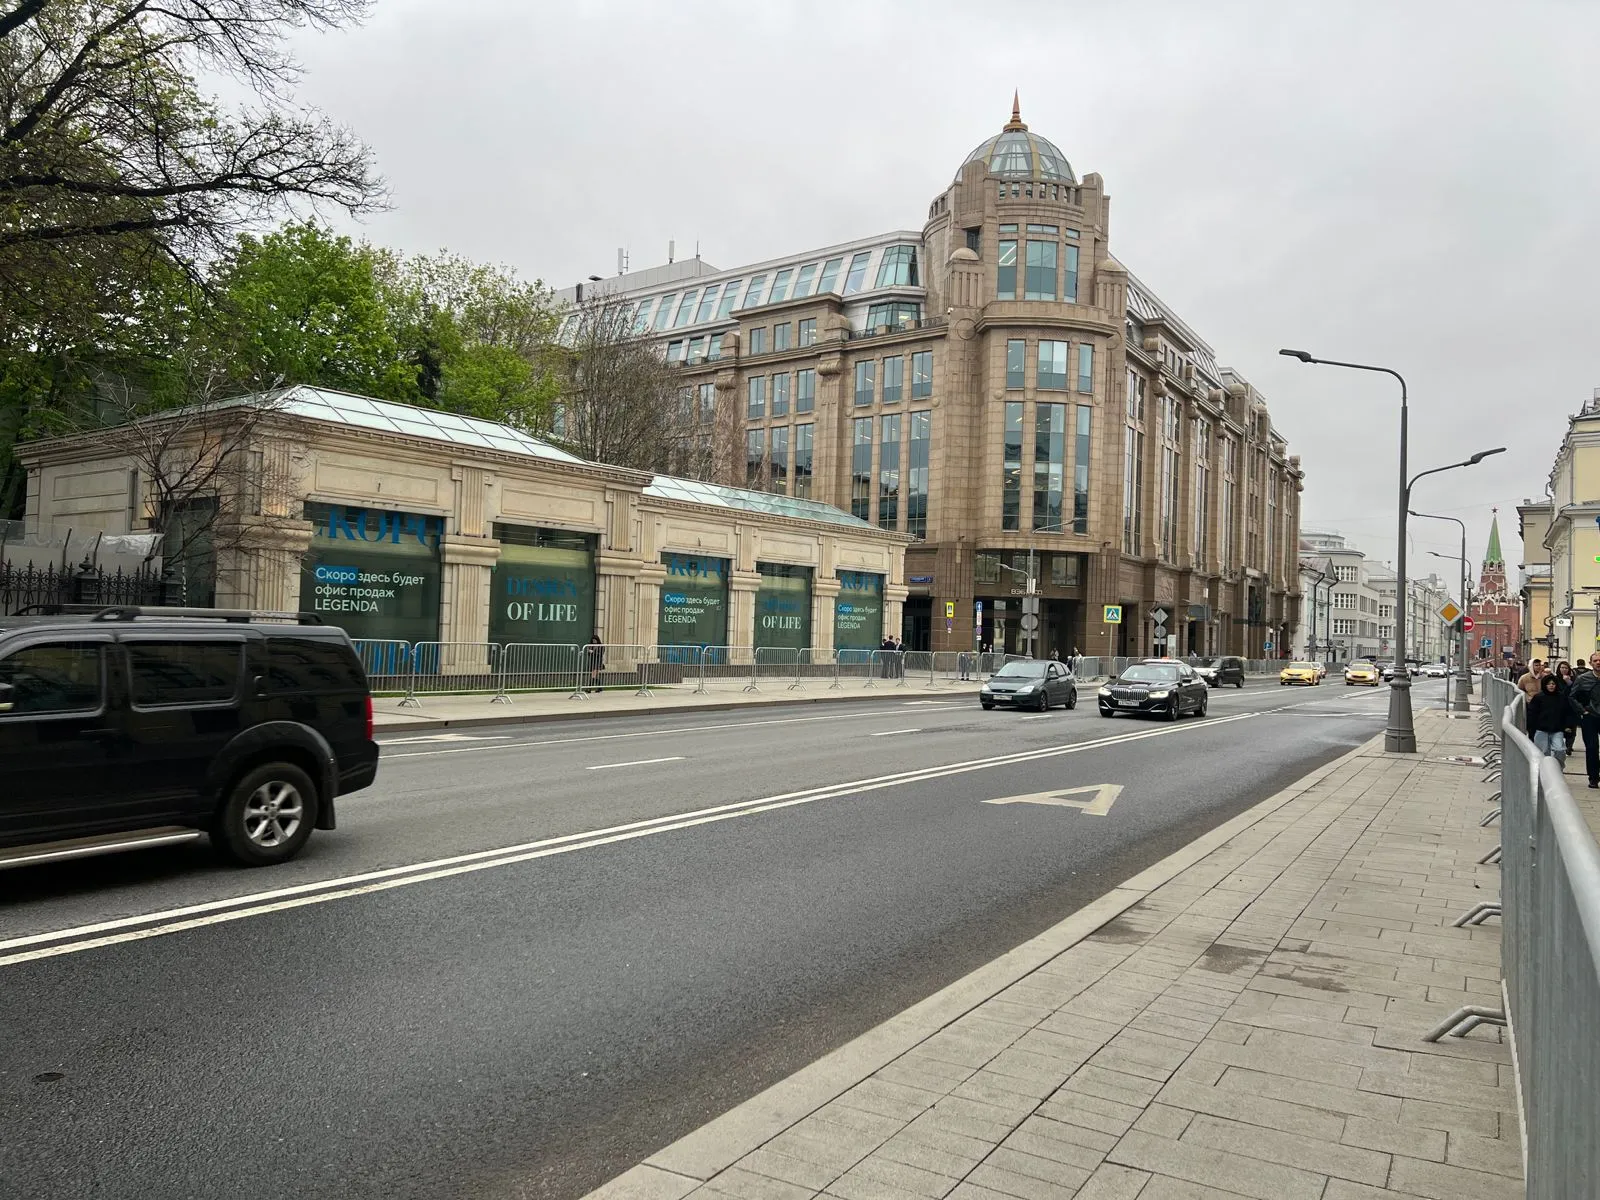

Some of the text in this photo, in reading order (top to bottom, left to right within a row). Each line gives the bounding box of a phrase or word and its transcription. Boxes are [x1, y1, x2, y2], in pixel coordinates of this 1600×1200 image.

[315, 567, 425, 586] Скоро здесь будет
[315, 584, 395, 600] офис продаж
[315, 599, 379, 613] LEGENDA
[664, 594, 720, 606] Скоро здесь будет
[506, 602, 577, 622] OF LIFE
[664, 605, 704, 615] офис продаж
[664, 615, 697, 624] LEGENDA
[762, 615, 801, 630] OF LIFE
